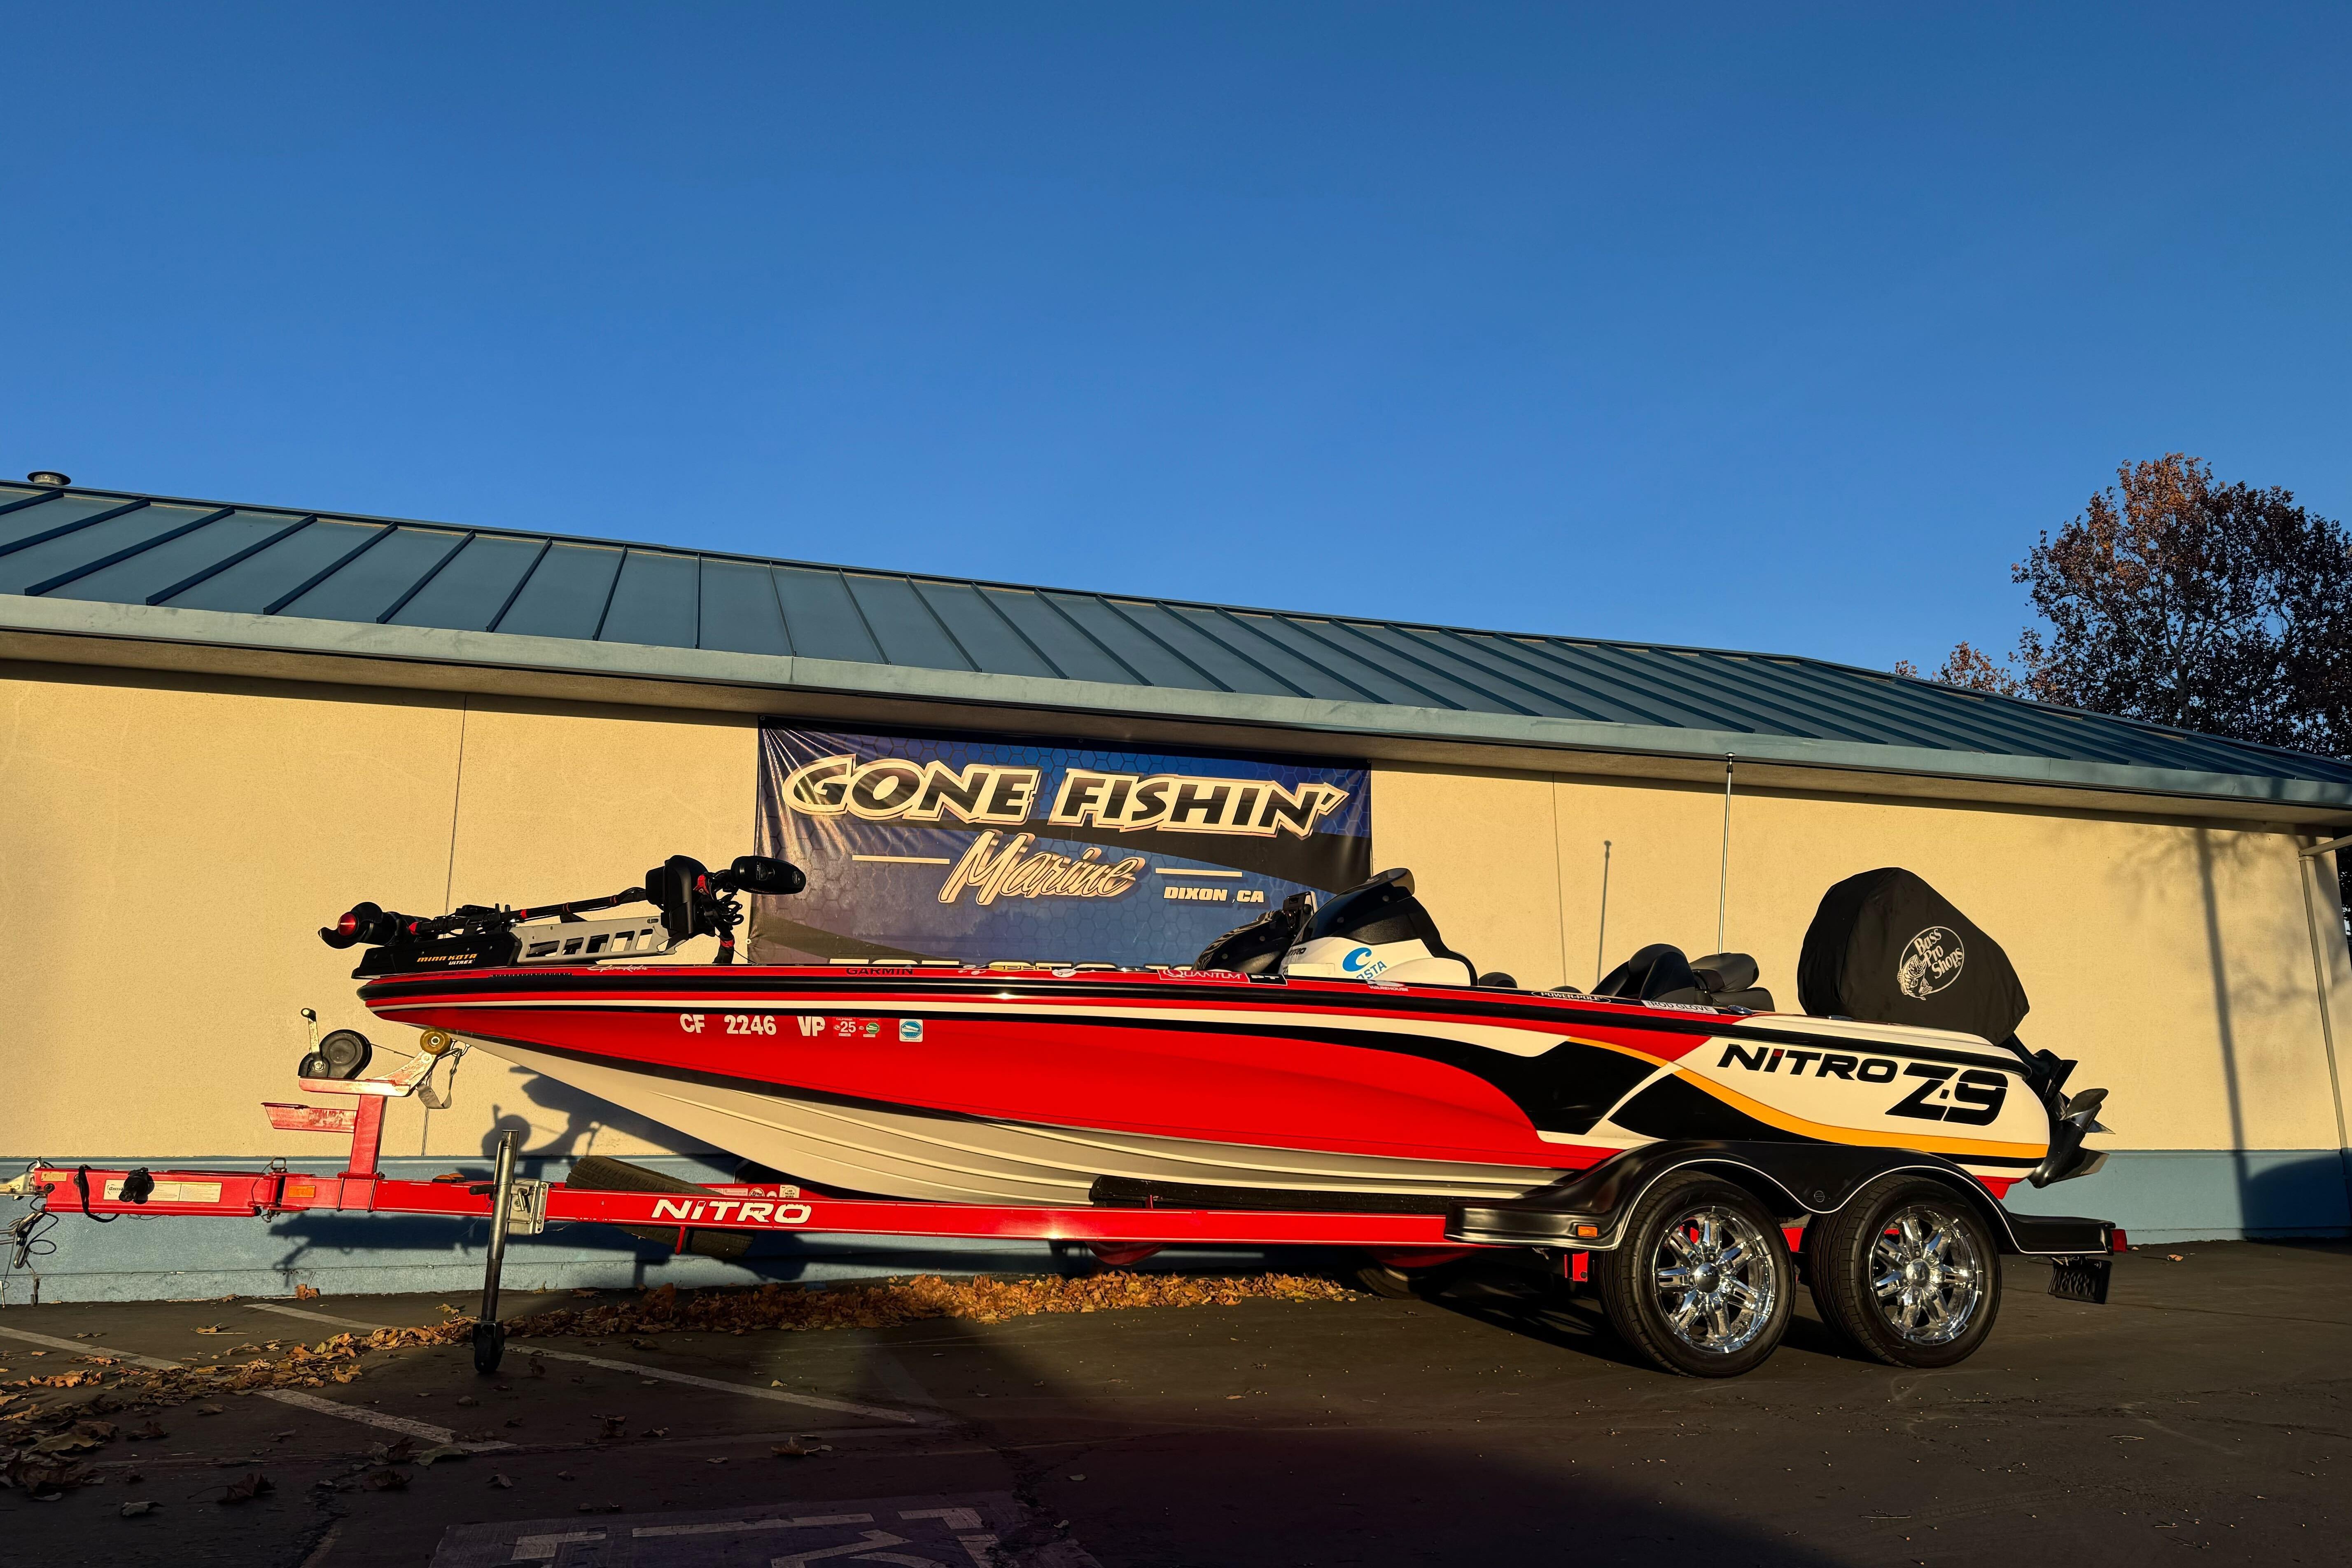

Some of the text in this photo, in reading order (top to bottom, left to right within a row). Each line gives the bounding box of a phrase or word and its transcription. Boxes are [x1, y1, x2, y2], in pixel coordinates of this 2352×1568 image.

[782, 754, 1350, 840] GONE FISHIN'
[938, 829, 1145, 905] Marine
[1164, 887, 1227, 901] DIXON
[1914, 929, 1941, 956] Bass
[1923, 945, 1944, 967] Pro
[1932, 948, 1963, 979] Shops
[1163, 969, 1241, 979] QUANTUM
[1541, 992, 1601, 1001] POWER-POLE
[680, 1014, 825, 1036] CF 2246 VP
[840, 1021, 856, 1033] 25
